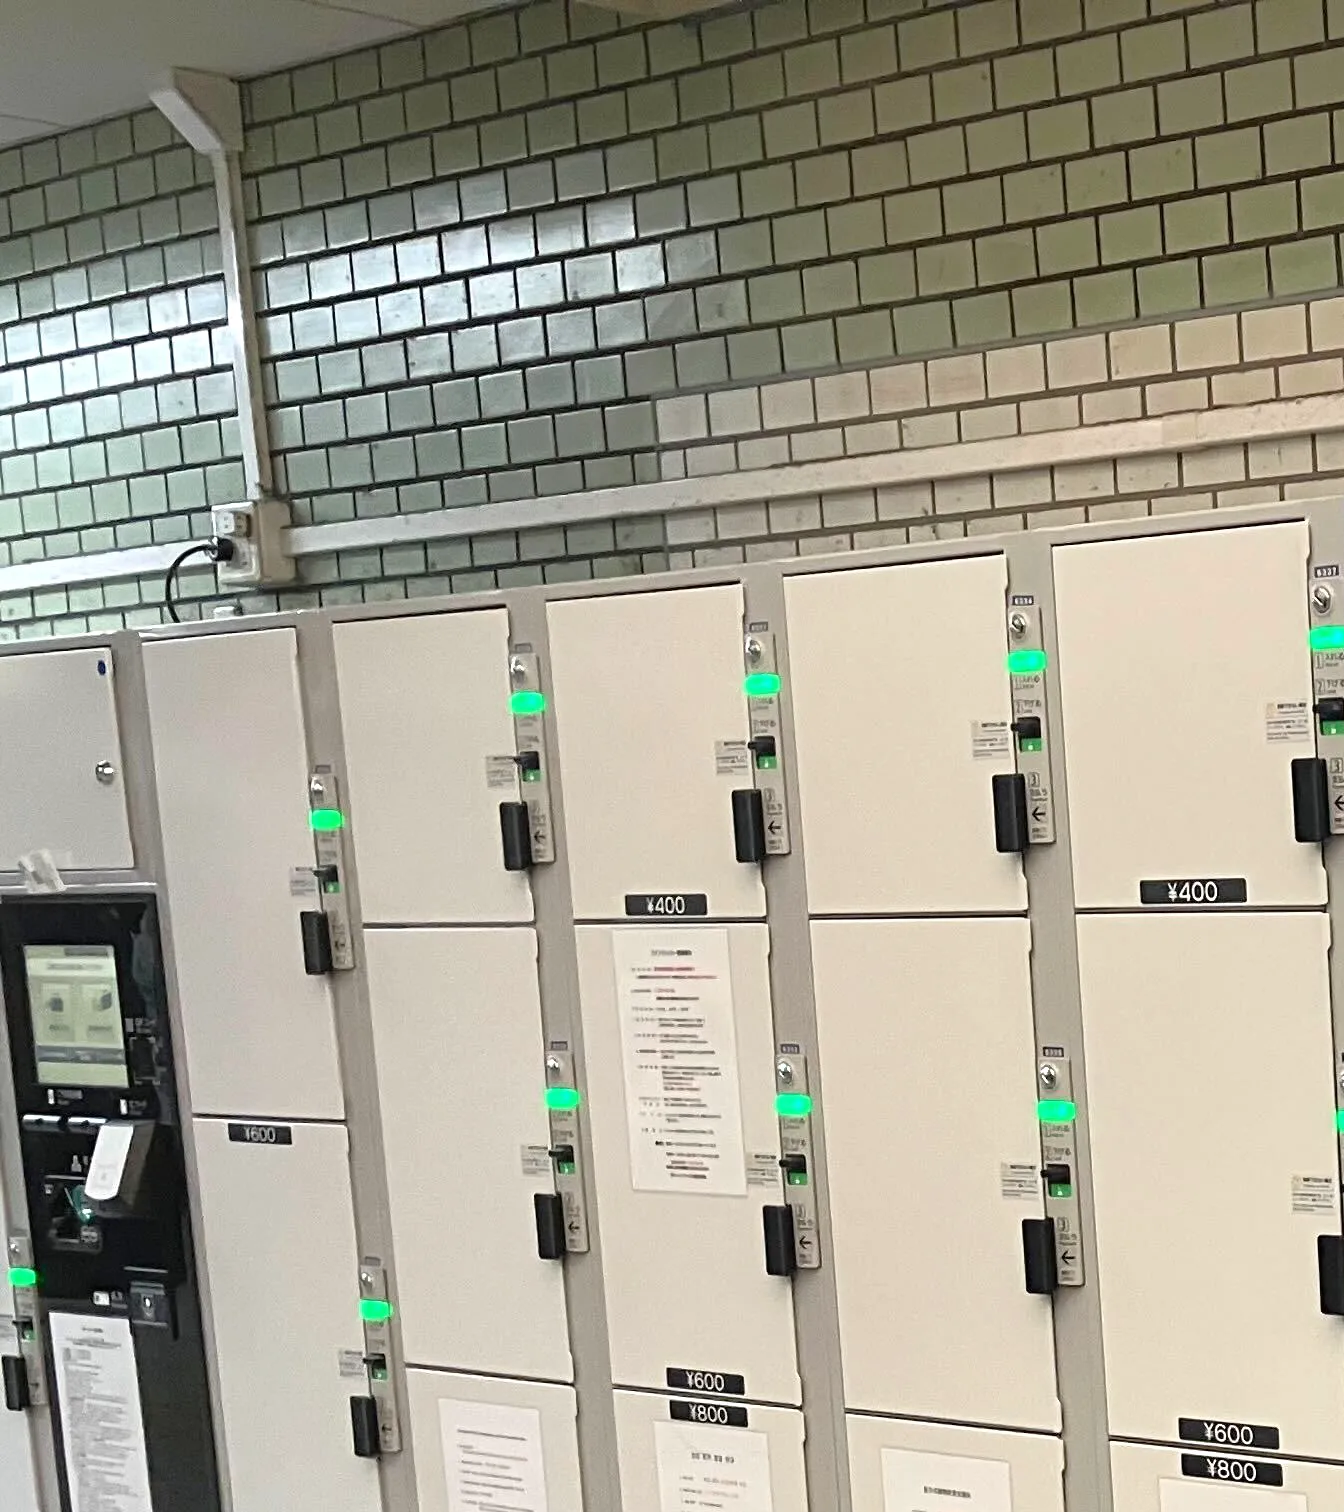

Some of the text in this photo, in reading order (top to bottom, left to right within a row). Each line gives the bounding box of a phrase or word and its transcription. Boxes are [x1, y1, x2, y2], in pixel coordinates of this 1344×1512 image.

[1168, 881, 1218, 902] ¥400
[646, 896, 685, 914] ¥400
[687, 1371, 724, 1392] ¥600
[689, 1403, 728, 1424] ¥800
[1204, 1422, 1253, 1445] ¥600
[1206, 1458, 1257, 1482] ¥800
